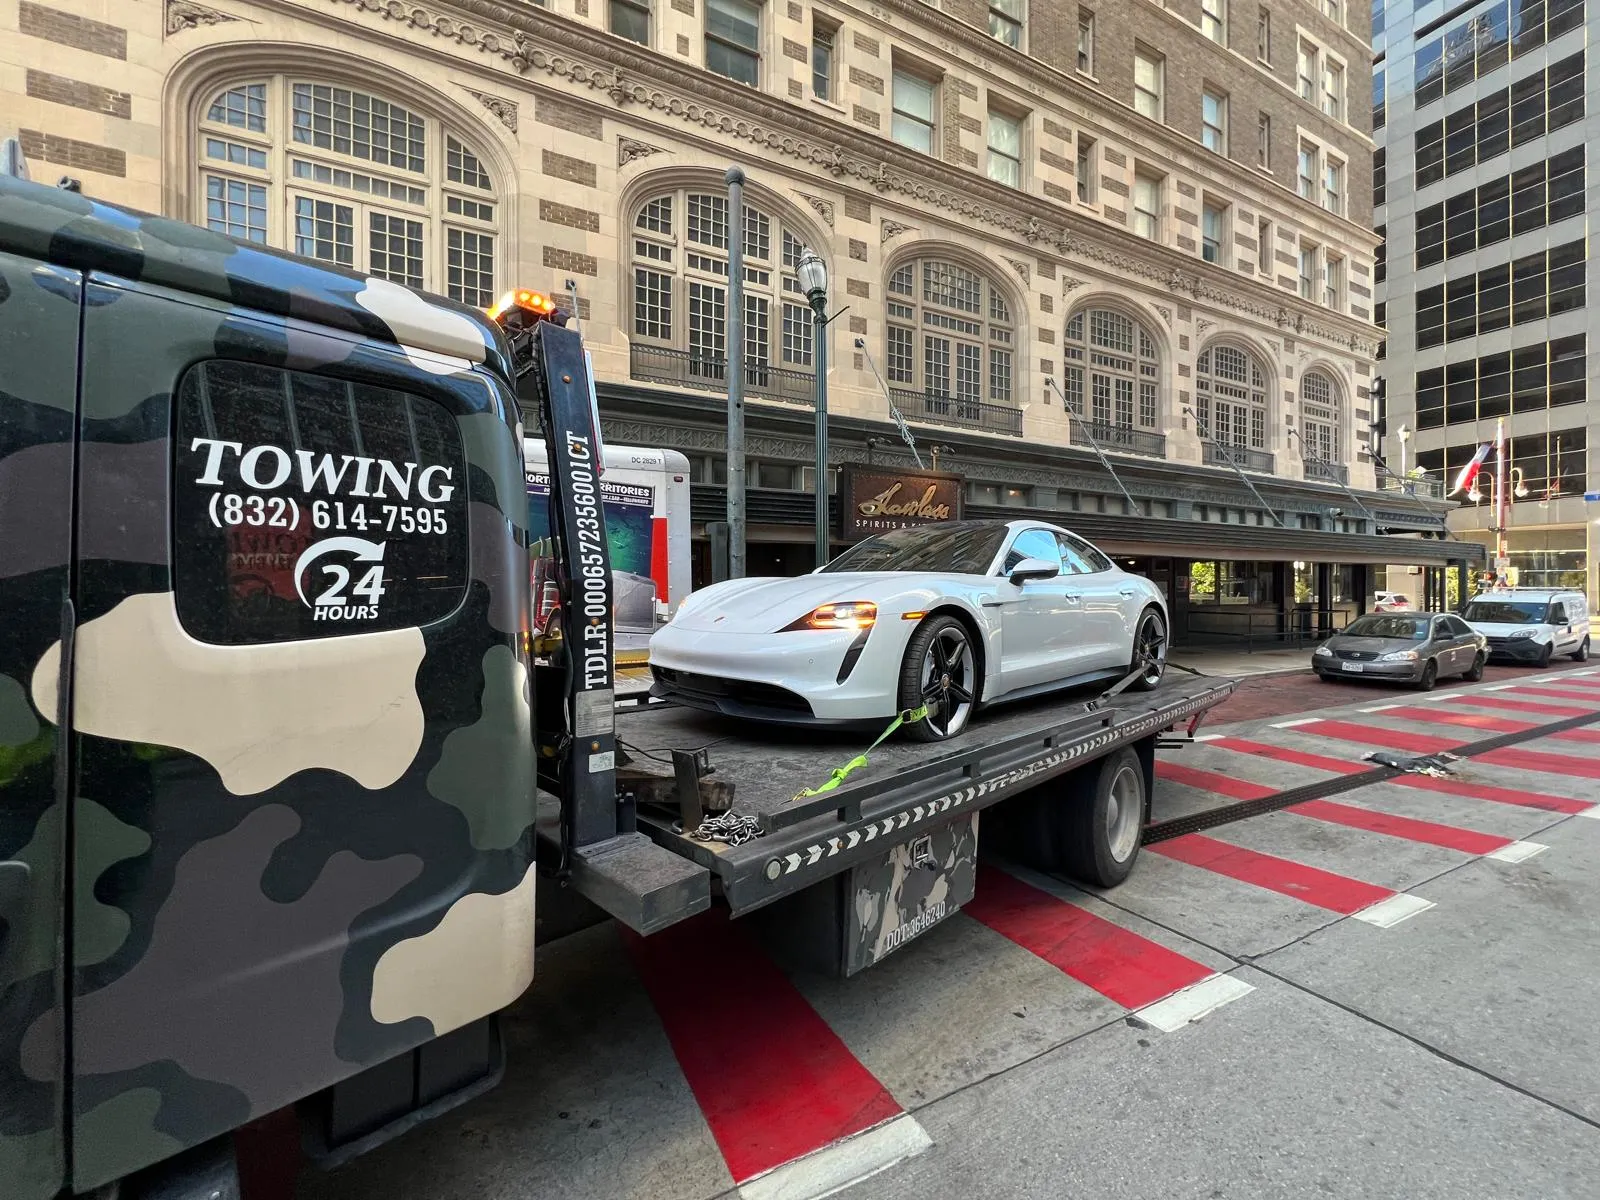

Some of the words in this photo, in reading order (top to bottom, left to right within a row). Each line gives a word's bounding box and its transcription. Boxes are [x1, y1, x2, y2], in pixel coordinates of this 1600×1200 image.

[191, 437, 455, 503] TOWING
[208, 492, 300, 531] (832)
[312, 499, 448, 535] 614-7595
[855, 519, 897, 529] SPIRITS
[314, 564, 386, 606] 24
[313, 604, 379, 621] HOURS
[584, 622, 607, 690] TDLR
[886, 900, 946, 951] DOT:3646240
